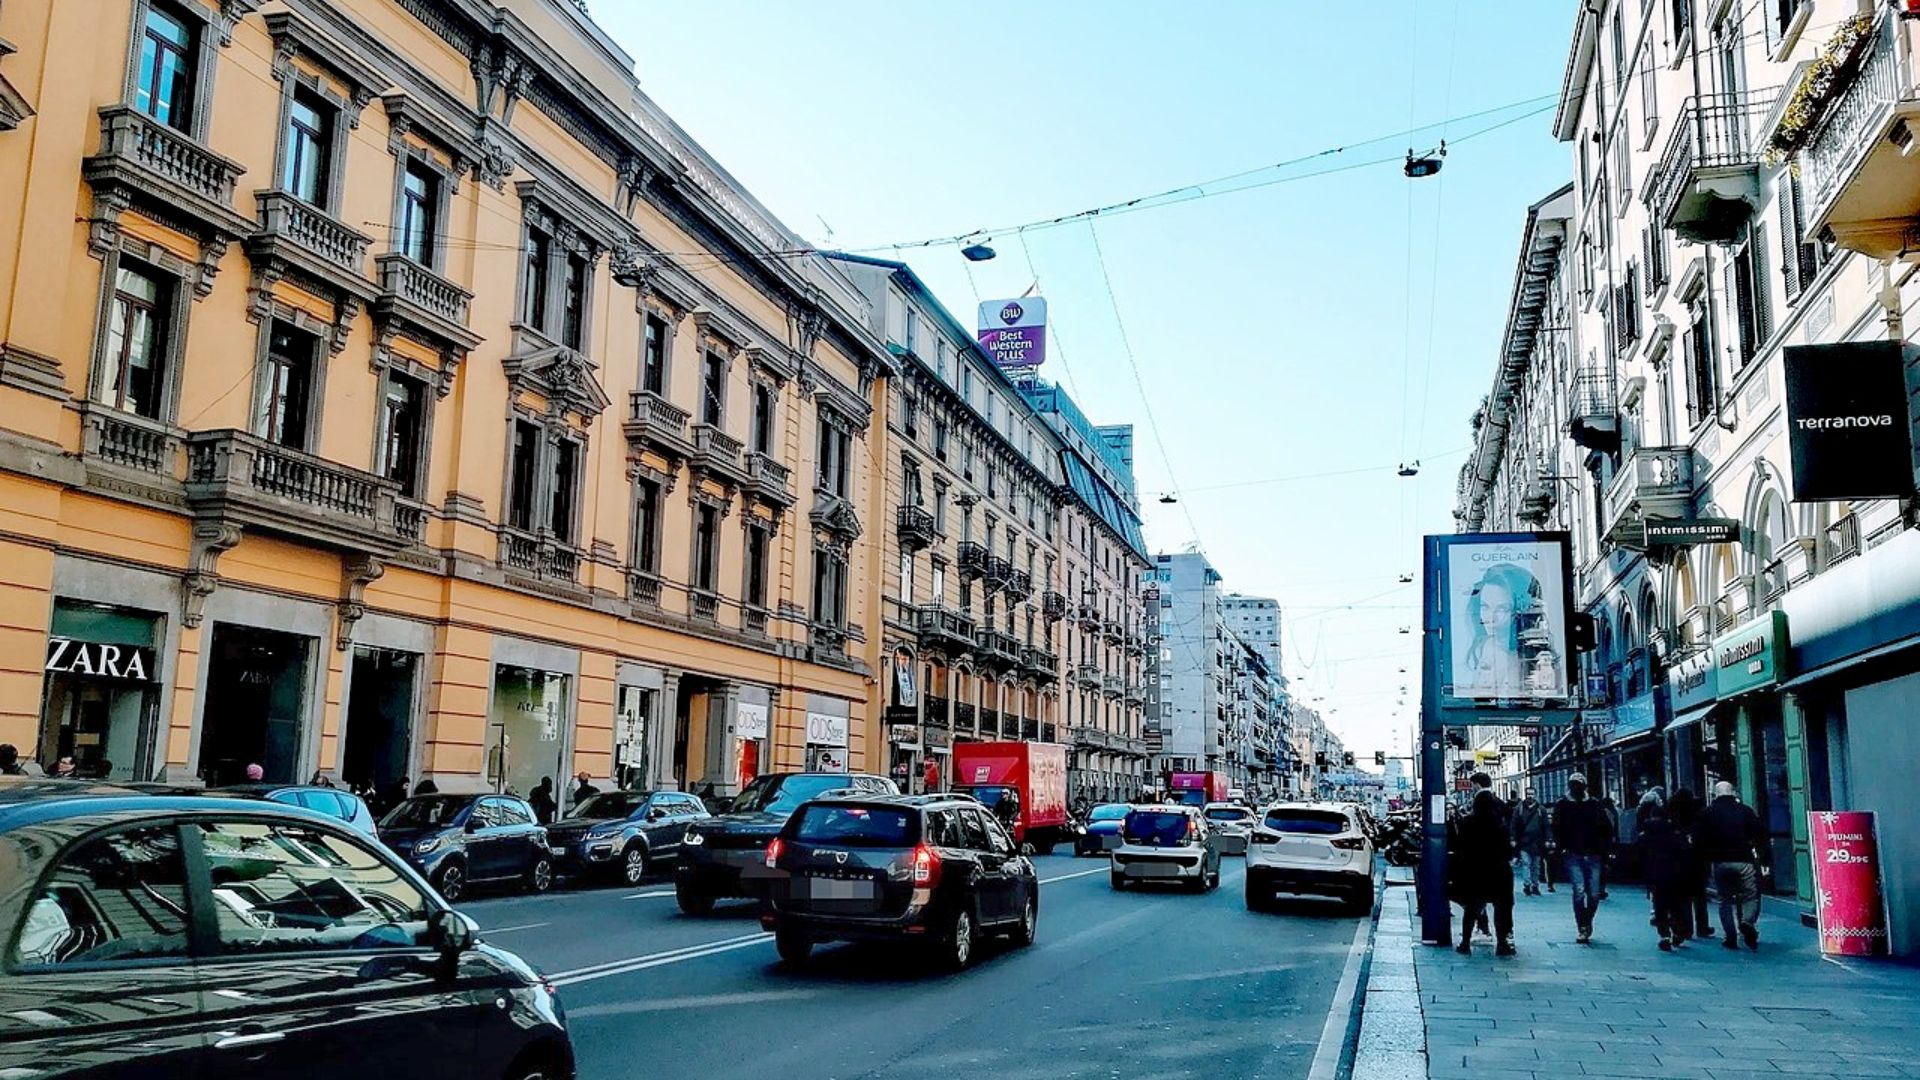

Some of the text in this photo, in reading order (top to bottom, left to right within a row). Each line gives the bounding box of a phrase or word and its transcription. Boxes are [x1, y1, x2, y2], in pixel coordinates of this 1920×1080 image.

[1002, 308, 1021, 319] BW
[1000, 331, 1023, 340] Best
[989, 340, 1033, 351] Western
[997, 350, 1025, 360] PLUS
[1648, 525, 1729, 535] intimissimi
[1471, 552, 1539, 562] GUERLAIN
[45, 638, 148, 680] ZARA
[1827, 833, 1863, 841] PIUMINI
